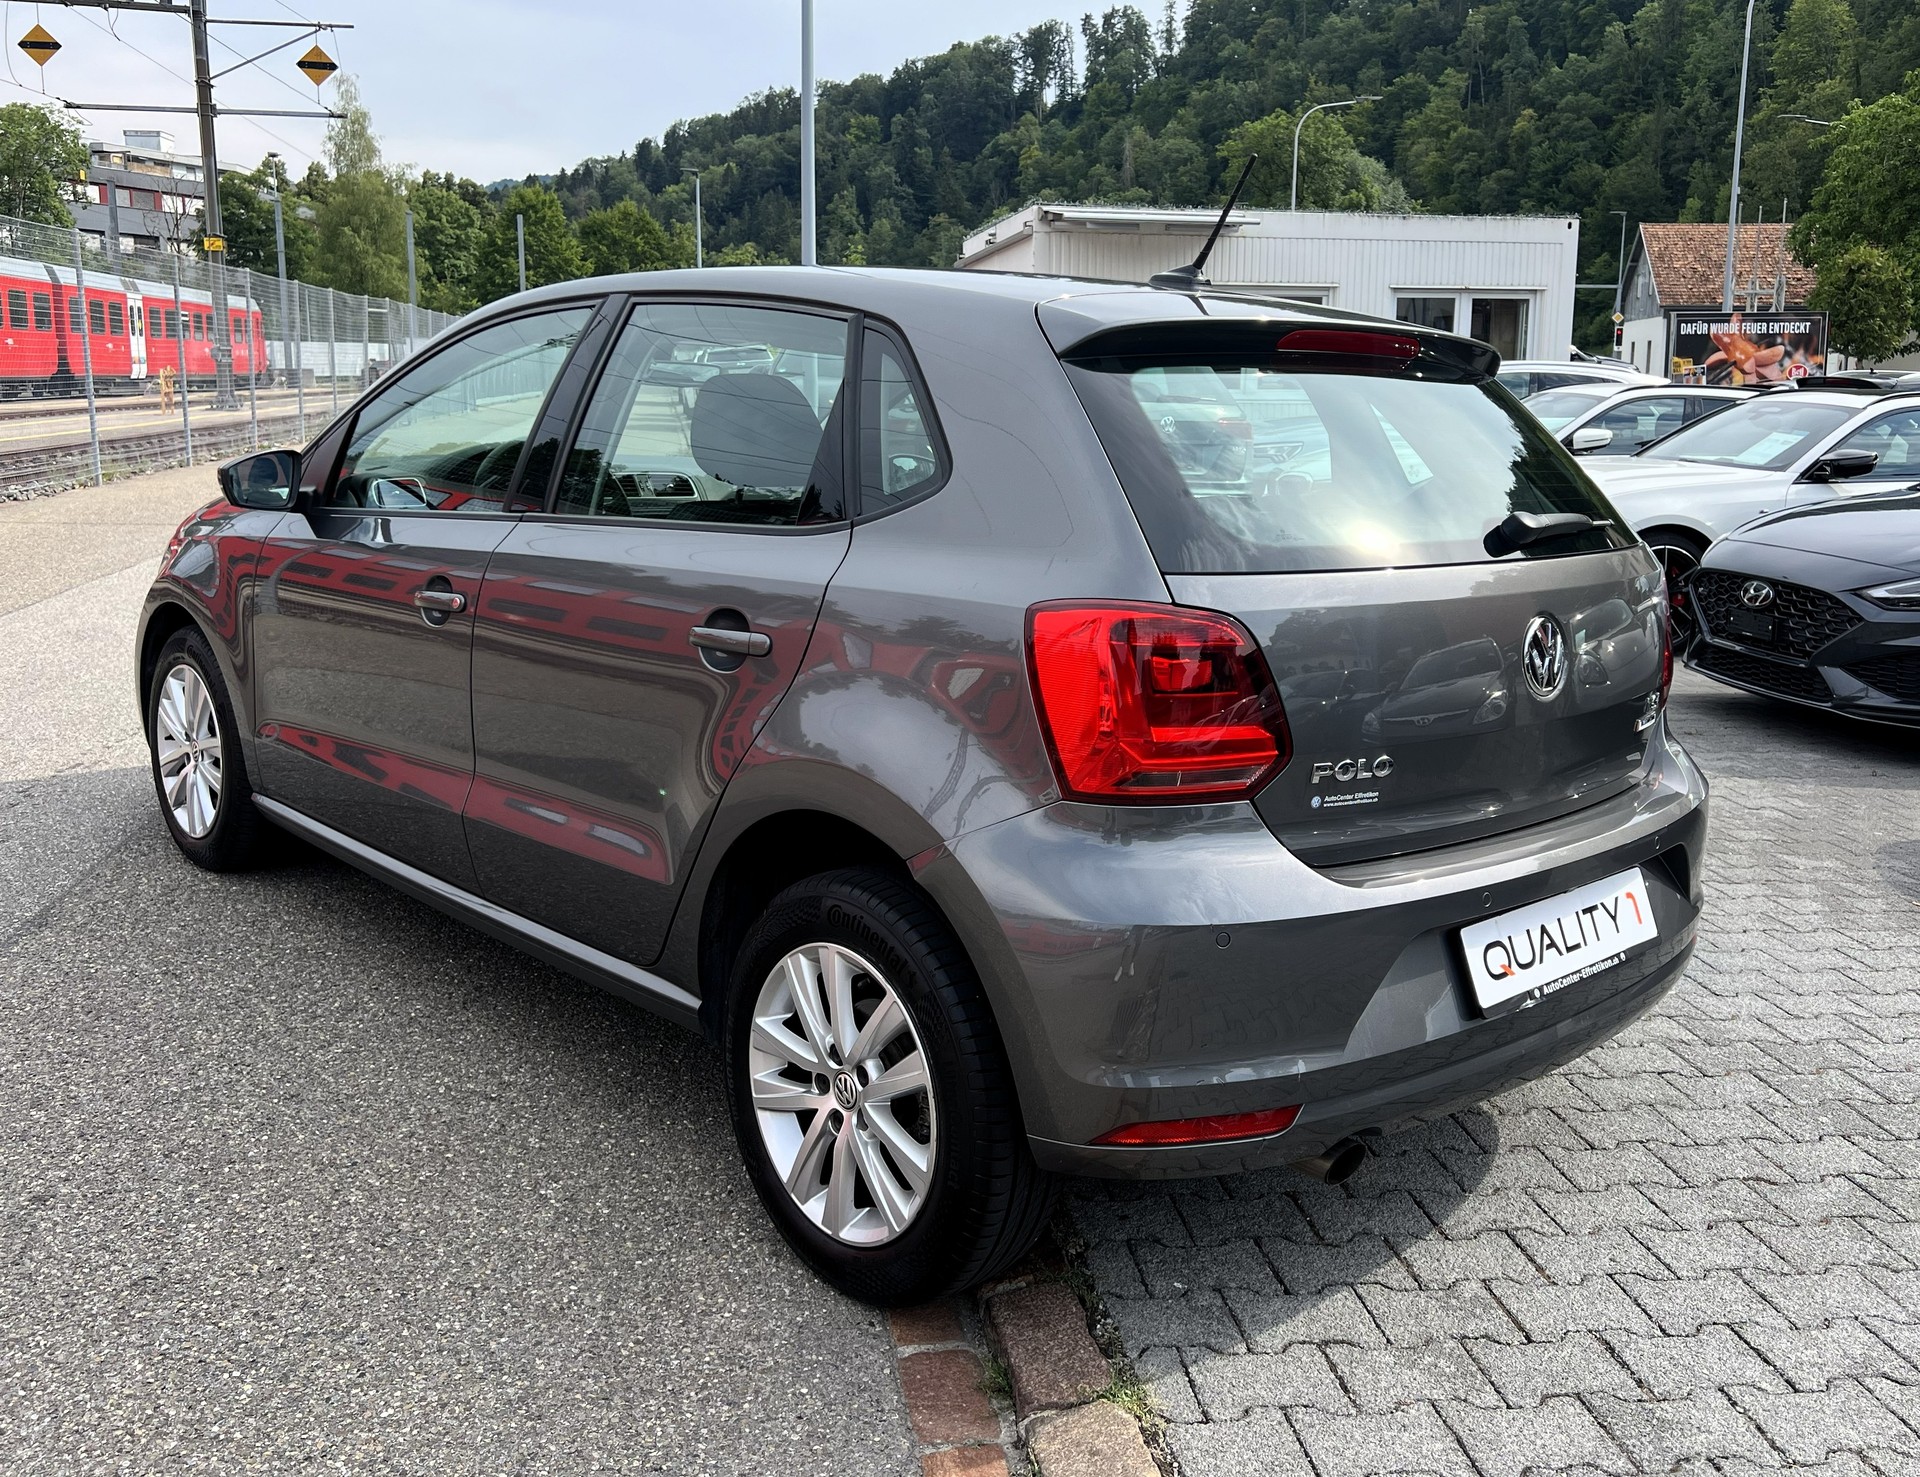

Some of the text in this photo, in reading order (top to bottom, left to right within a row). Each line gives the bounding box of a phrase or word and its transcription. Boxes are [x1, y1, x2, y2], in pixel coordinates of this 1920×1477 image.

[1680, 320, 1811, 335] DAFÜR WURDE FEUER ENTDECKT
[1311, 754, 1394, 784] POLO
[1324, 794, 1354, 802] AutoCenter
[827, 903, 909, 976] Continental
[1483, 891, 1643, 981] QUALITY 1
[1543, 956, 1620, 995] AutoCenter-Effretikon.ch
